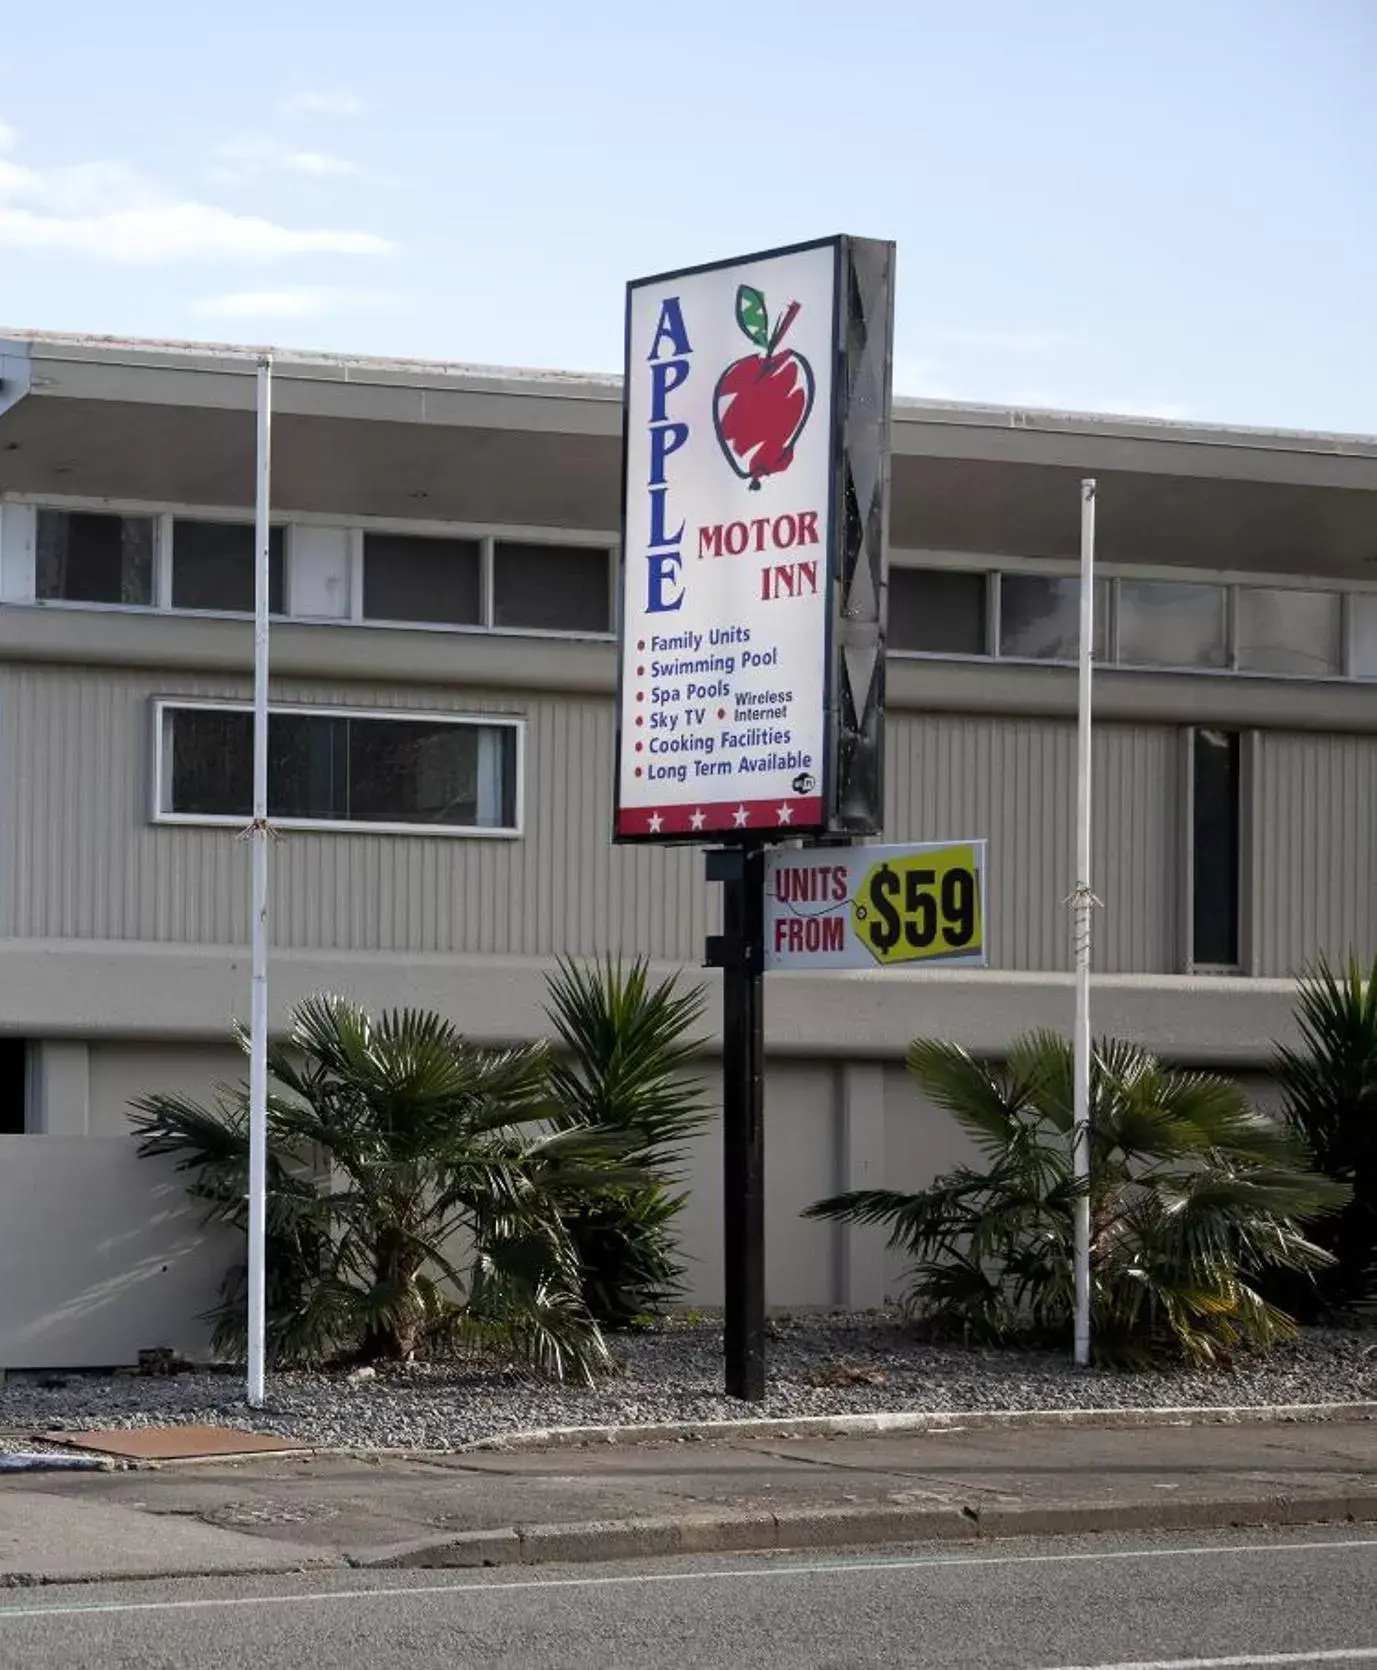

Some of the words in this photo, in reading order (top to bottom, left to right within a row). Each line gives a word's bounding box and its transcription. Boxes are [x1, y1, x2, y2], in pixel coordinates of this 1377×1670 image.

[645, 296, 694, 614] APPLE
[698, 511, 820, 559] MOTOR
[761, 561, 818, 601] INN
[651, 631, 702, 652] Family
[709, 626, 750, 645] Units
[651, 656, 735, 678] Swimming
[741, 647, 777, 669] Pool
[651, 687, 680, 706] Spa
[687, 680, 730, 700] Pools
[735, 690, 793, 706] Wireless
[650, 713, 679, 731] Sky
[685, 708, 706, 726] TV
[734, 705, 787, 722] Internet
[649, 734, 714, 754] Cooking
[721, 728, 791, 749] Facilities
[647, 764, 687, 782] Long
[694, 758, 732, 777] Term
[738, 751, 812, 773] Available
[776, 866, 848, 903] UNITS
[869, 862, 974, 955] $59
[775, 917, 845, 953] FROM
